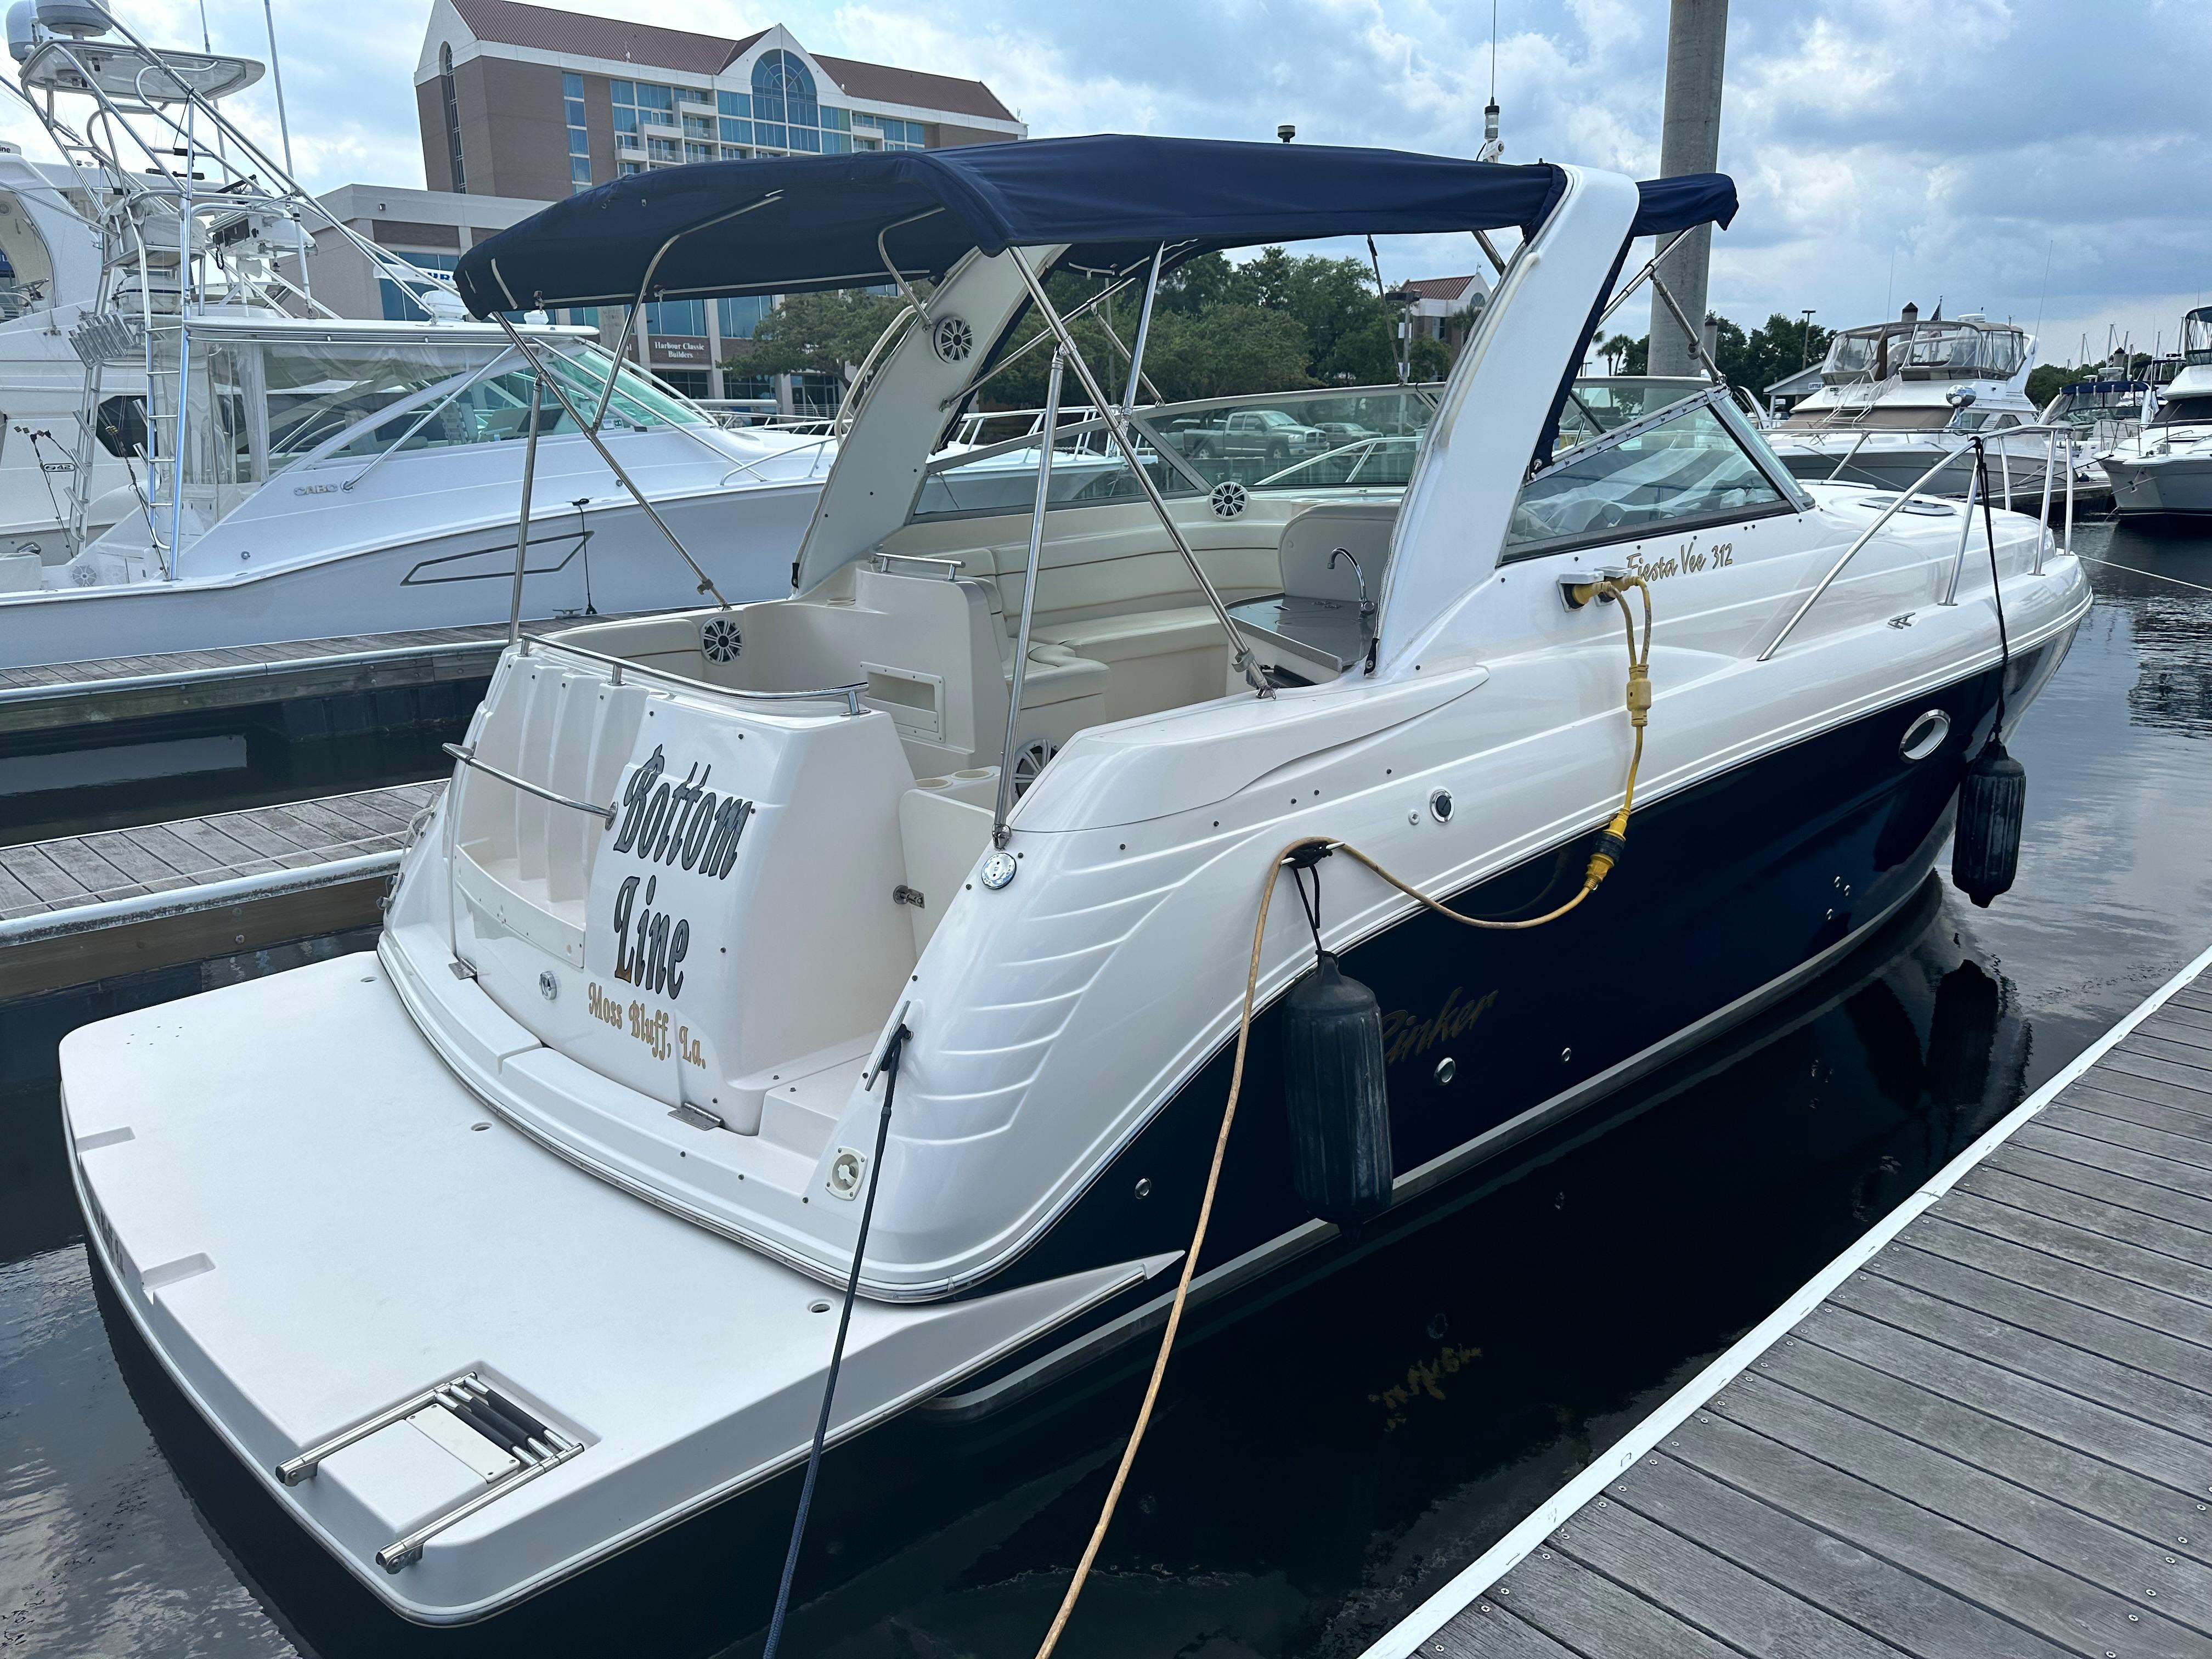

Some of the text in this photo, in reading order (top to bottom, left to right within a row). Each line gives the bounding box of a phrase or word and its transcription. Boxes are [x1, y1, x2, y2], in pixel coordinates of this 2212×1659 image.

[654, 341, 705, 351] Harbour Classic
[294, 483, 338, 496] CABO
[1626, 541, 1734, 582] Fiesta Vee 312
[613, 743, 753, 881] Bottom
[613, 874, 690, 1000] Line
[588, 981, 707, 1069] Moss Bluff, La.
